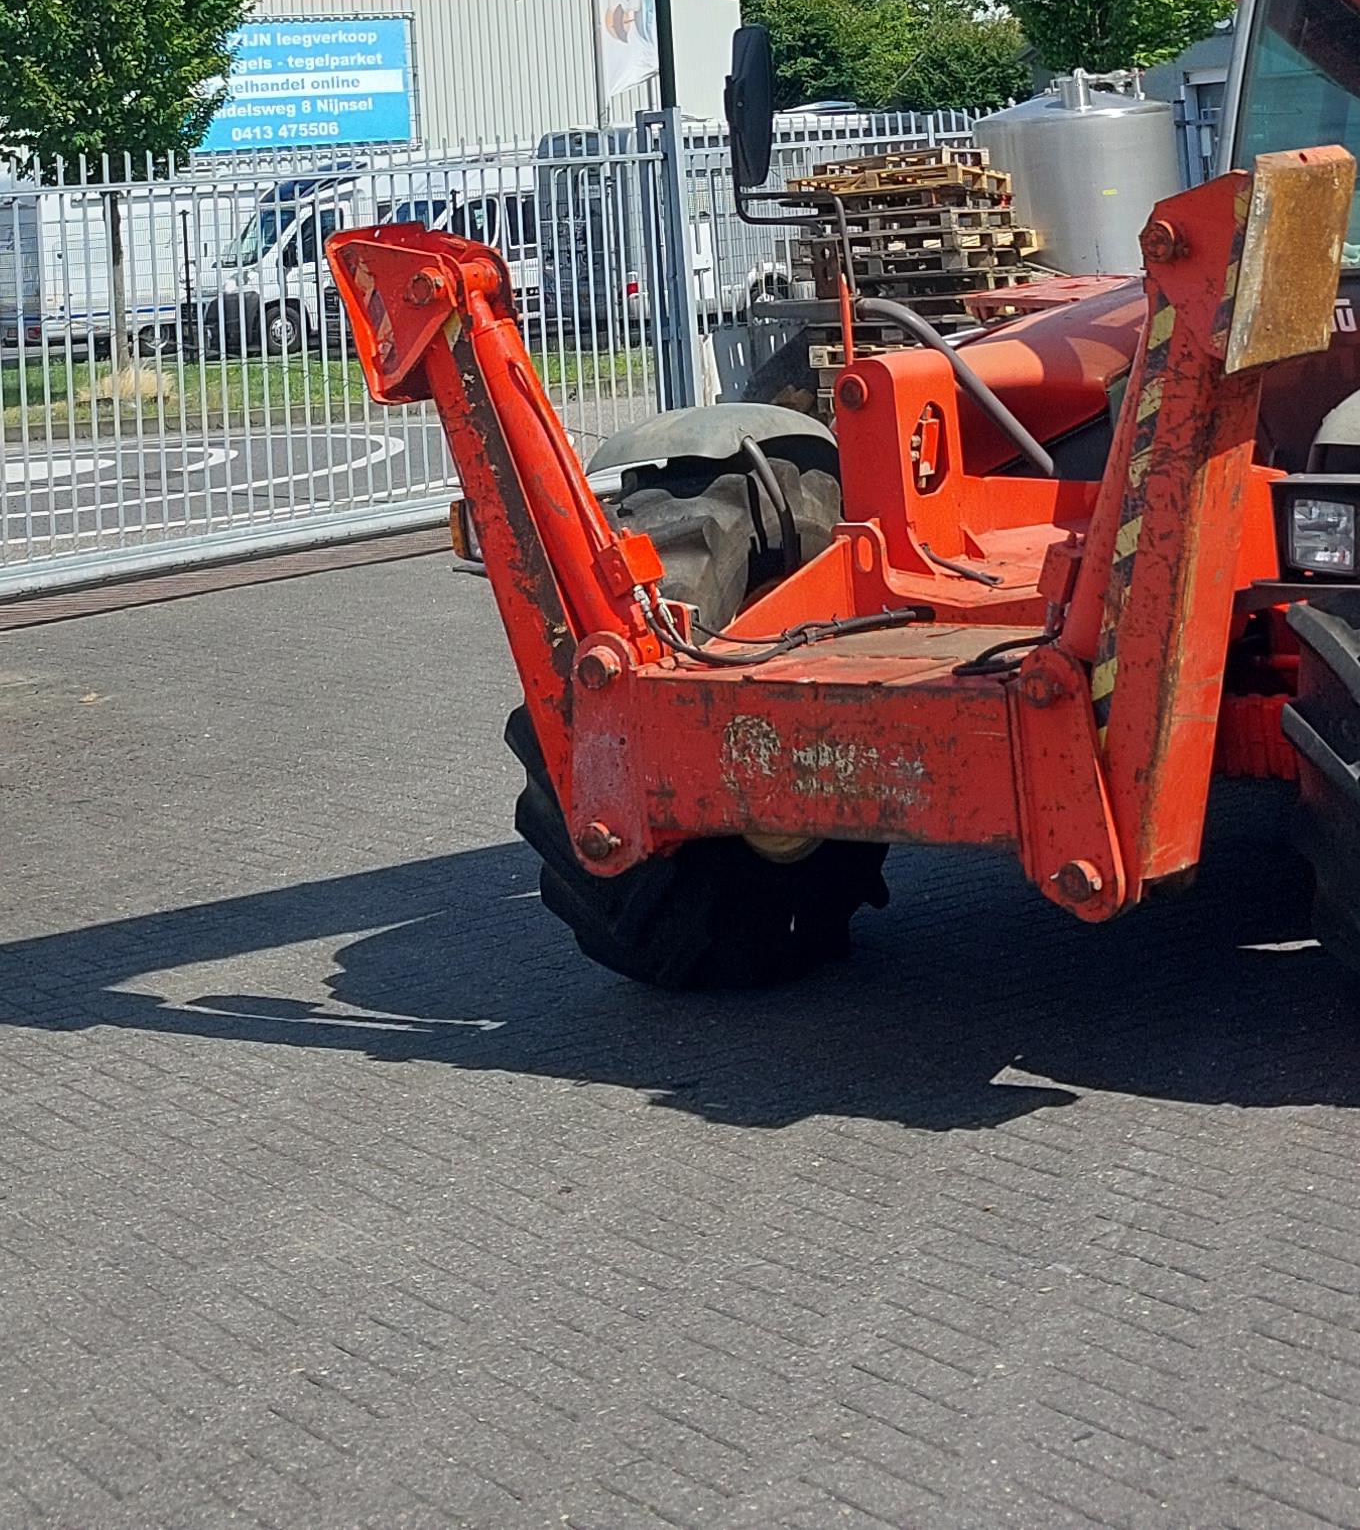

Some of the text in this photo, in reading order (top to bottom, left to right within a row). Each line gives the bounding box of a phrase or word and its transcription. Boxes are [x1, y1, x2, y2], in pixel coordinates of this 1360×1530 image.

[276, 29, 377, 47] leegverkoop
[233, 55, 273, 74] gels
[287, 52, 383, 70] tegelparket
[310, 76, 361, 90] online
[301, 100, 312, 114] 8
[316, 97, 373, 115] Nijnsel
[231, 121, 339, 141] 0413 475506
